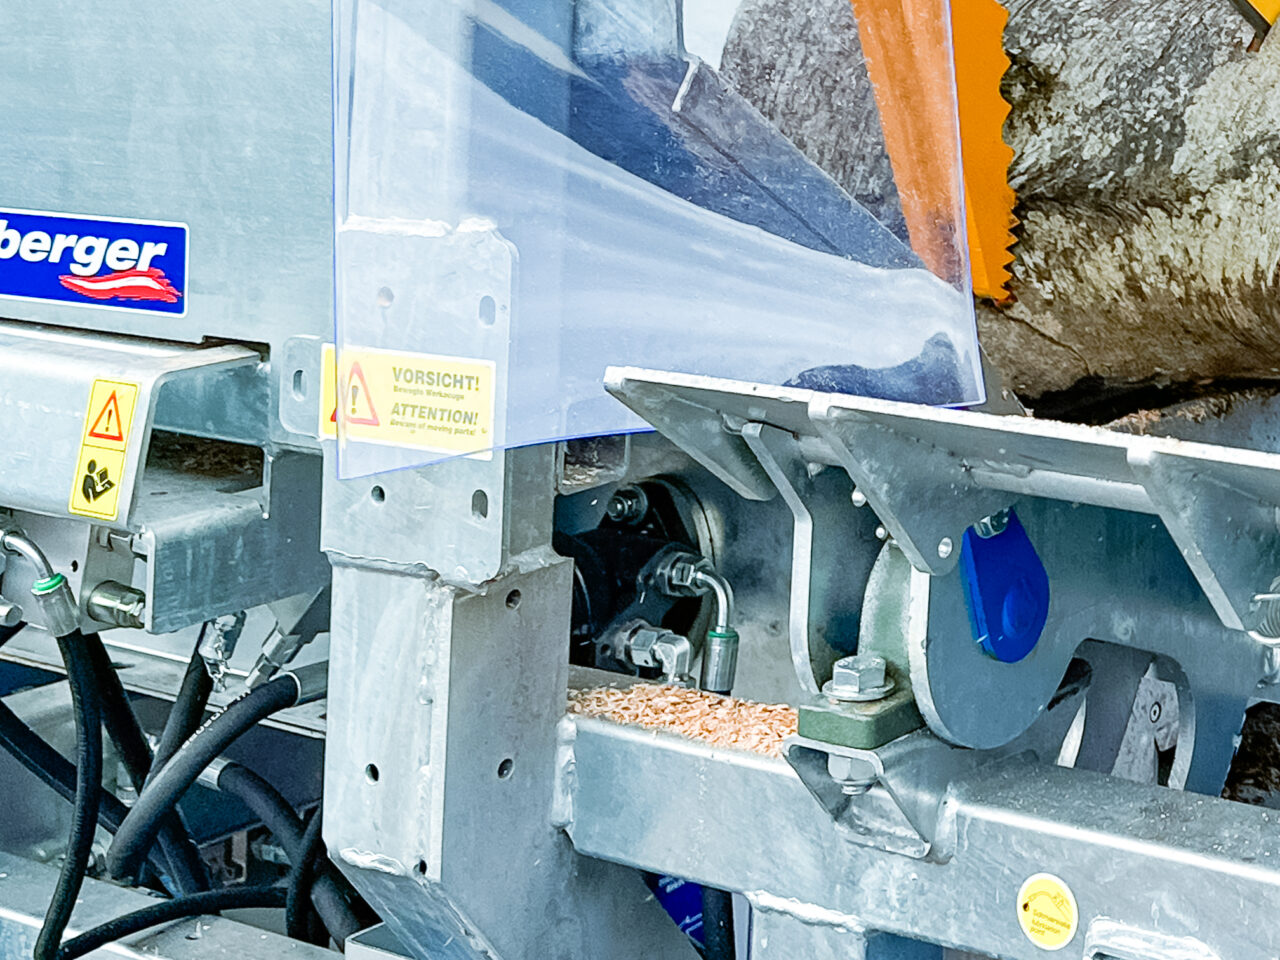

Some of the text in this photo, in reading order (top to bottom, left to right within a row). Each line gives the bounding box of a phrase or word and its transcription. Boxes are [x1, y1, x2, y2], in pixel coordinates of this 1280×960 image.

[0, 219, 168, 276] berger
[392, 366, 479, 391] VORSICHT!
[391, 402, 479, 426] ATTENTION!
[427, 424, 452, 434] moving
